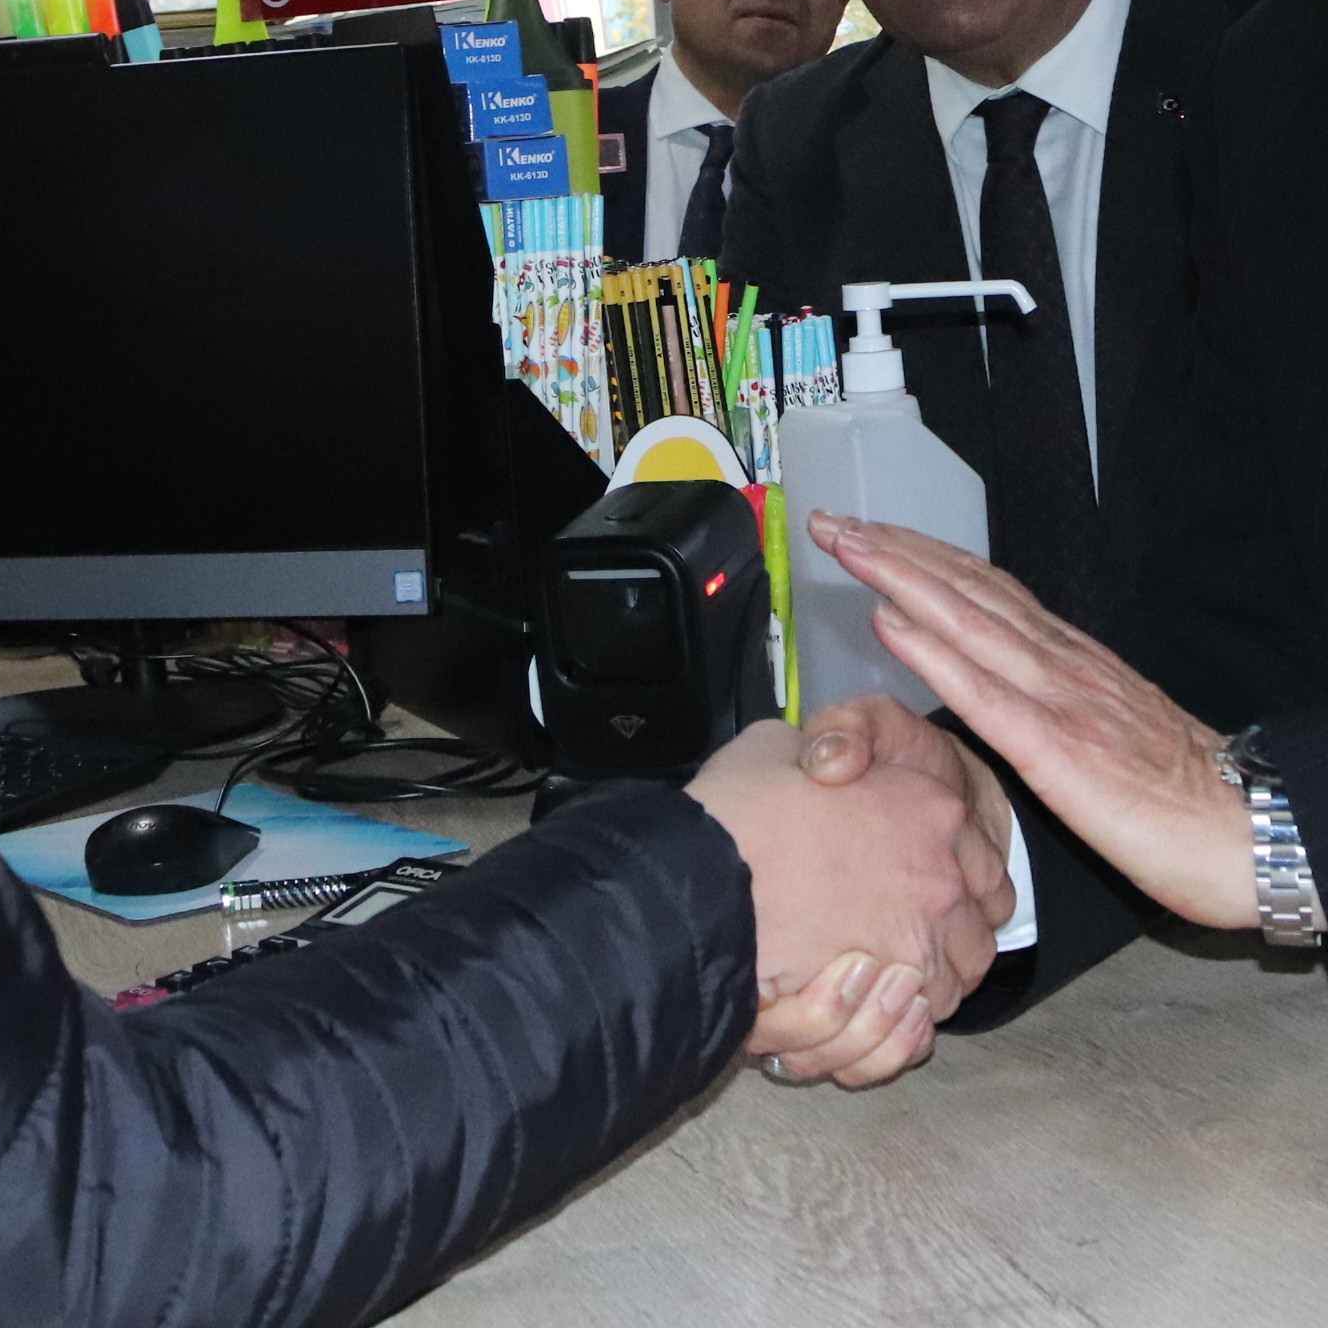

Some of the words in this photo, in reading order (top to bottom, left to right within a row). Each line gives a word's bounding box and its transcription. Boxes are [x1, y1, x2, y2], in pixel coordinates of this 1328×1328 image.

[454, 31, 507, 50] KENKO
[465, 54, 503, 64] KK-613D
[480, 91, 536, 111] KENKO
[493, 113, 532, 125] KK-613D
[498, 147, 554, 167] KENKO
[510, 170, 549, 182] KK-613D
